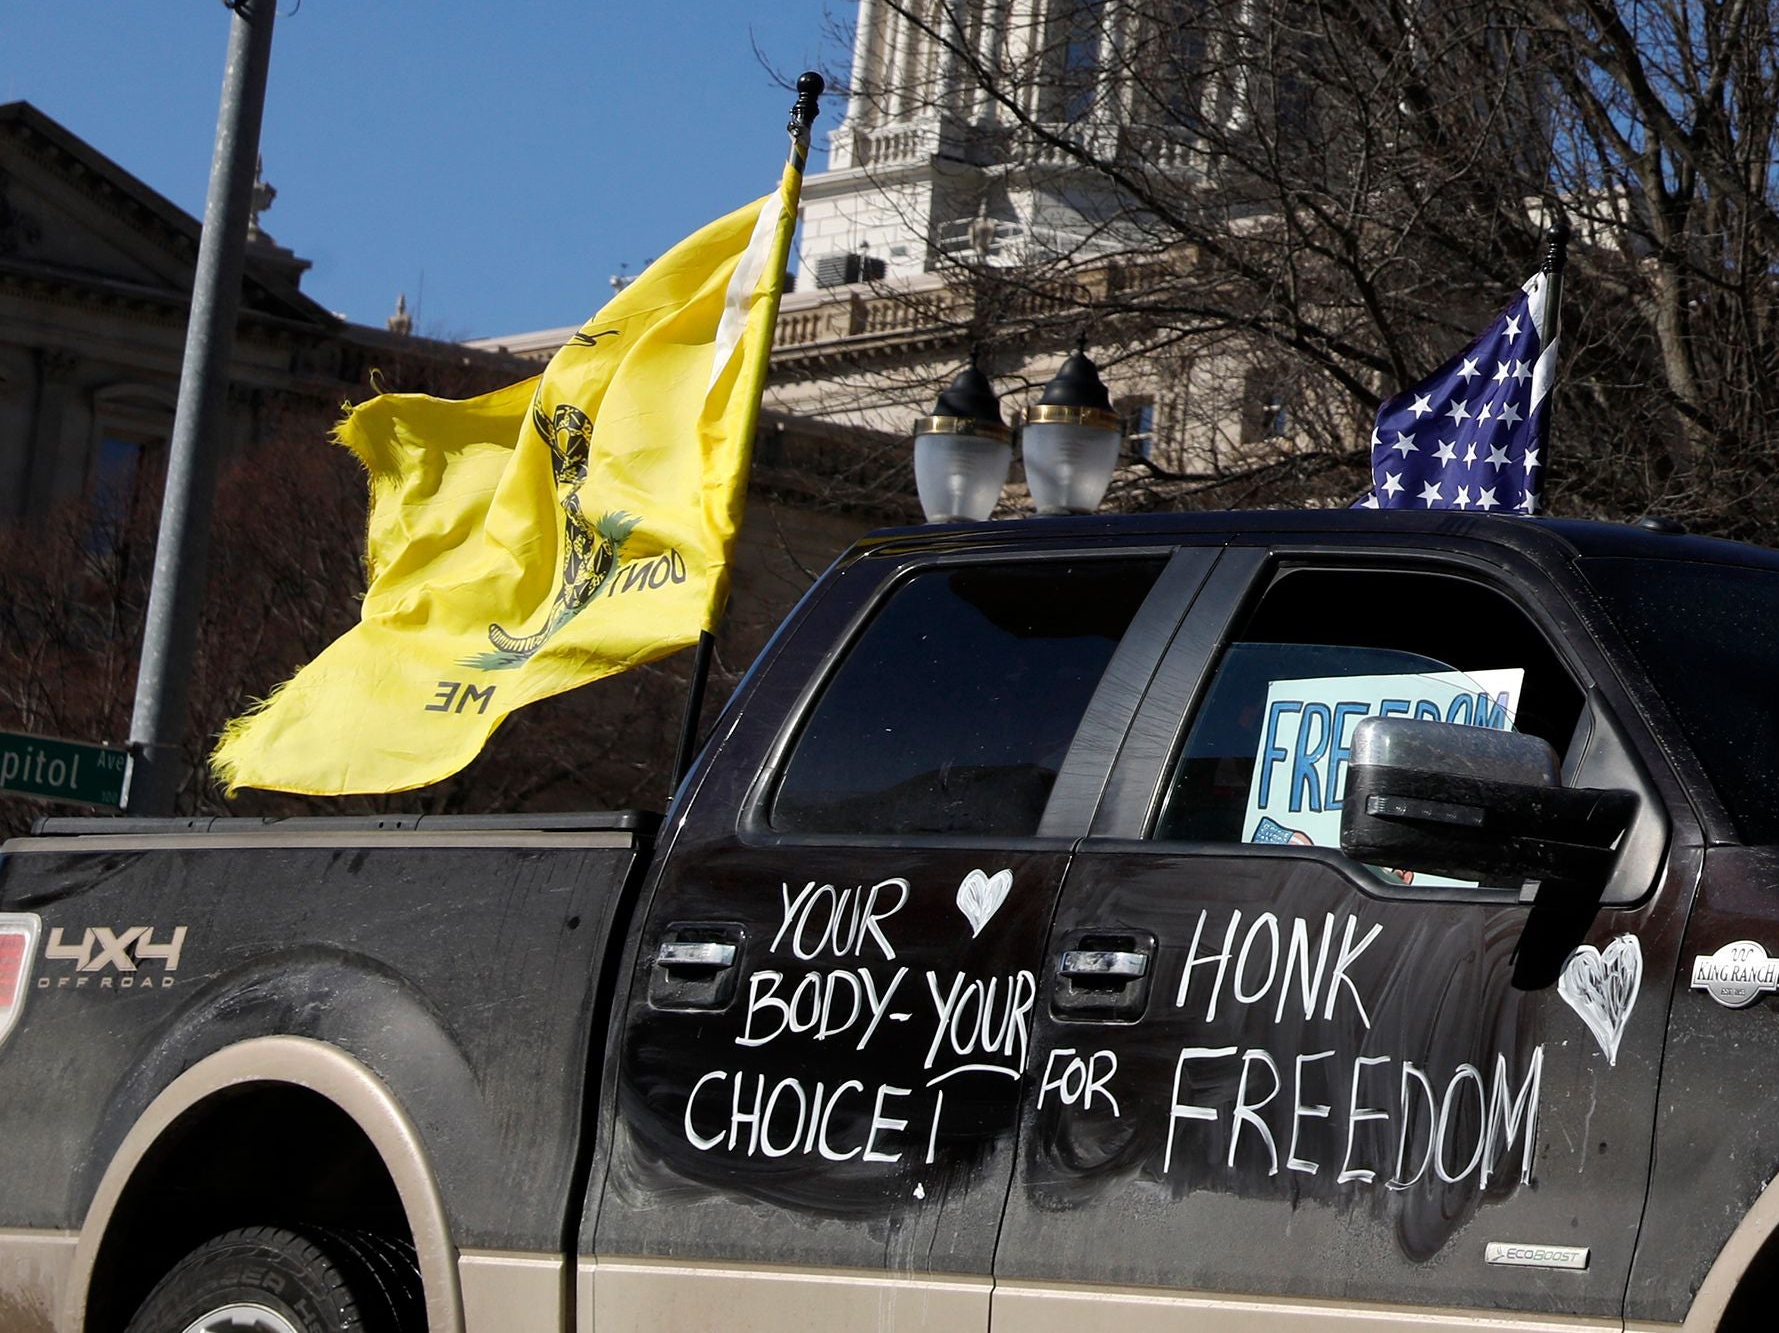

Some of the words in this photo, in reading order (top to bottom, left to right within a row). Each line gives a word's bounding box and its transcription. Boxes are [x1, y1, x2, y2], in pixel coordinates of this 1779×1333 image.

[97, 750, 125, 771] Ave
[769, 877, 911, 961] YOUR
[45, 926, 188, 972] 4X4
[1176, 909, 1384, 1029] HONK
[38, 977, 89, 988] OFF
[100, 977, 175, 988] ROAD
[1697, 962, 1729, 982] KING
[1731, 964, 1776, 983] RANCH
[1037, 1048, 1119, 1117] FOR
[1163, 1045, 1544, 1190] FREEDOM
